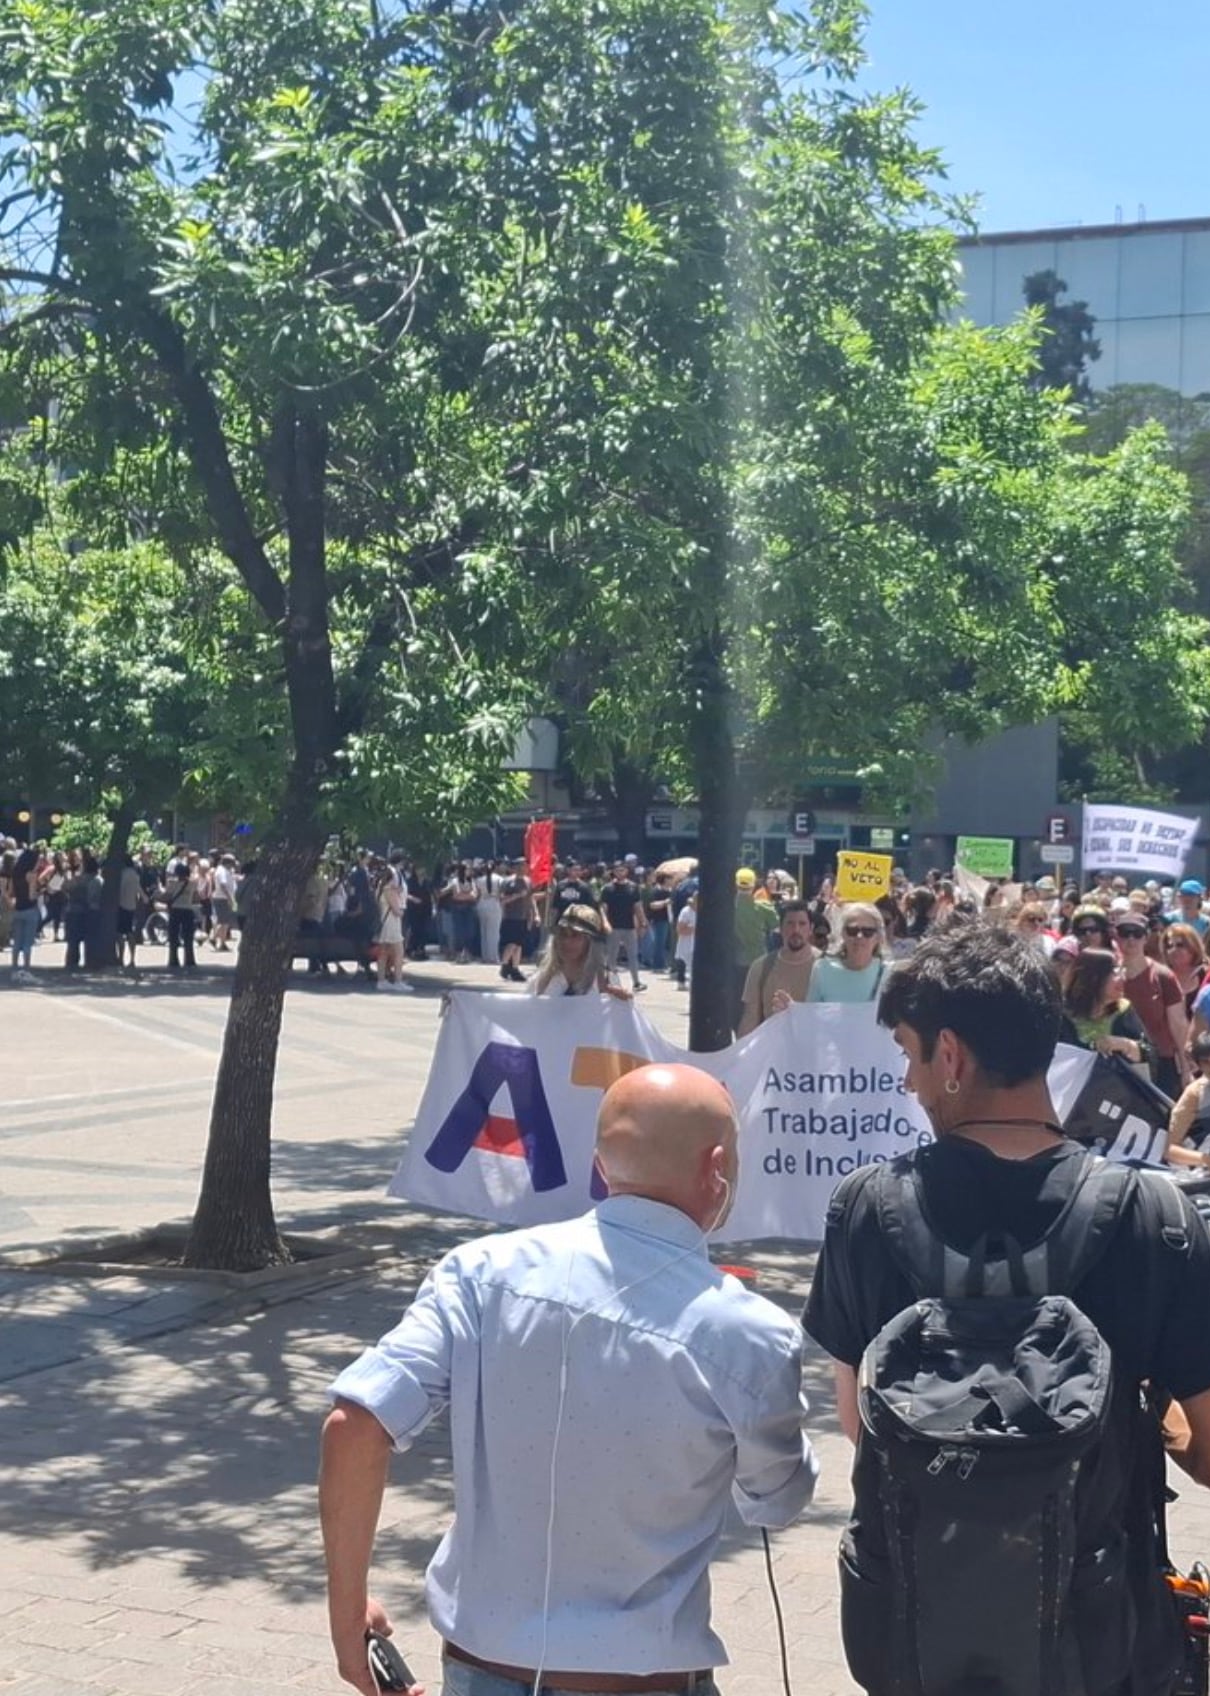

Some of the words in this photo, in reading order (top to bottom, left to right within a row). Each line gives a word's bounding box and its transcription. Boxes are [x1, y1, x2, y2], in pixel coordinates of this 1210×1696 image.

[795, 813, 809, 832] E
[1050, 818, 1065, 843] E
[844, 859, 858, 868] NO
[865, 862, 880, 872] AL
[851, 873, 882, 885] VETO
[762, 1107, 933, 1148] Trabajadoe
[763, 1148, 797, 1175] de
